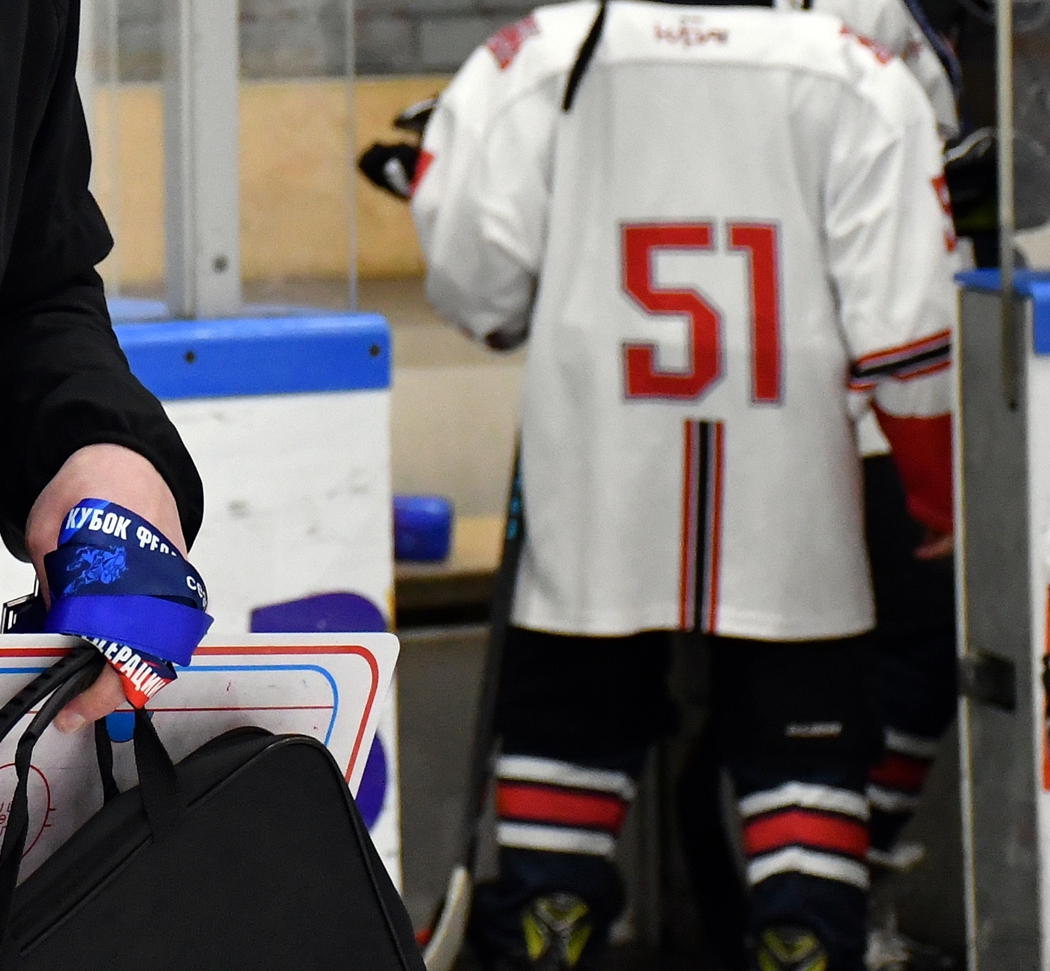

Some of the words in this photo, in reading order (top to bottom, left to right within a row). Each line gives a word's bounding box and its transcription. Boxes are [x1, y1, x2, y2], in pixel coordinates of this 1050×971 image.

[618, 217, 786, 408] 51
[65, 506, 132, 541] КУБОК
[82, 634, 167, 699] ЕРАЦИИ
